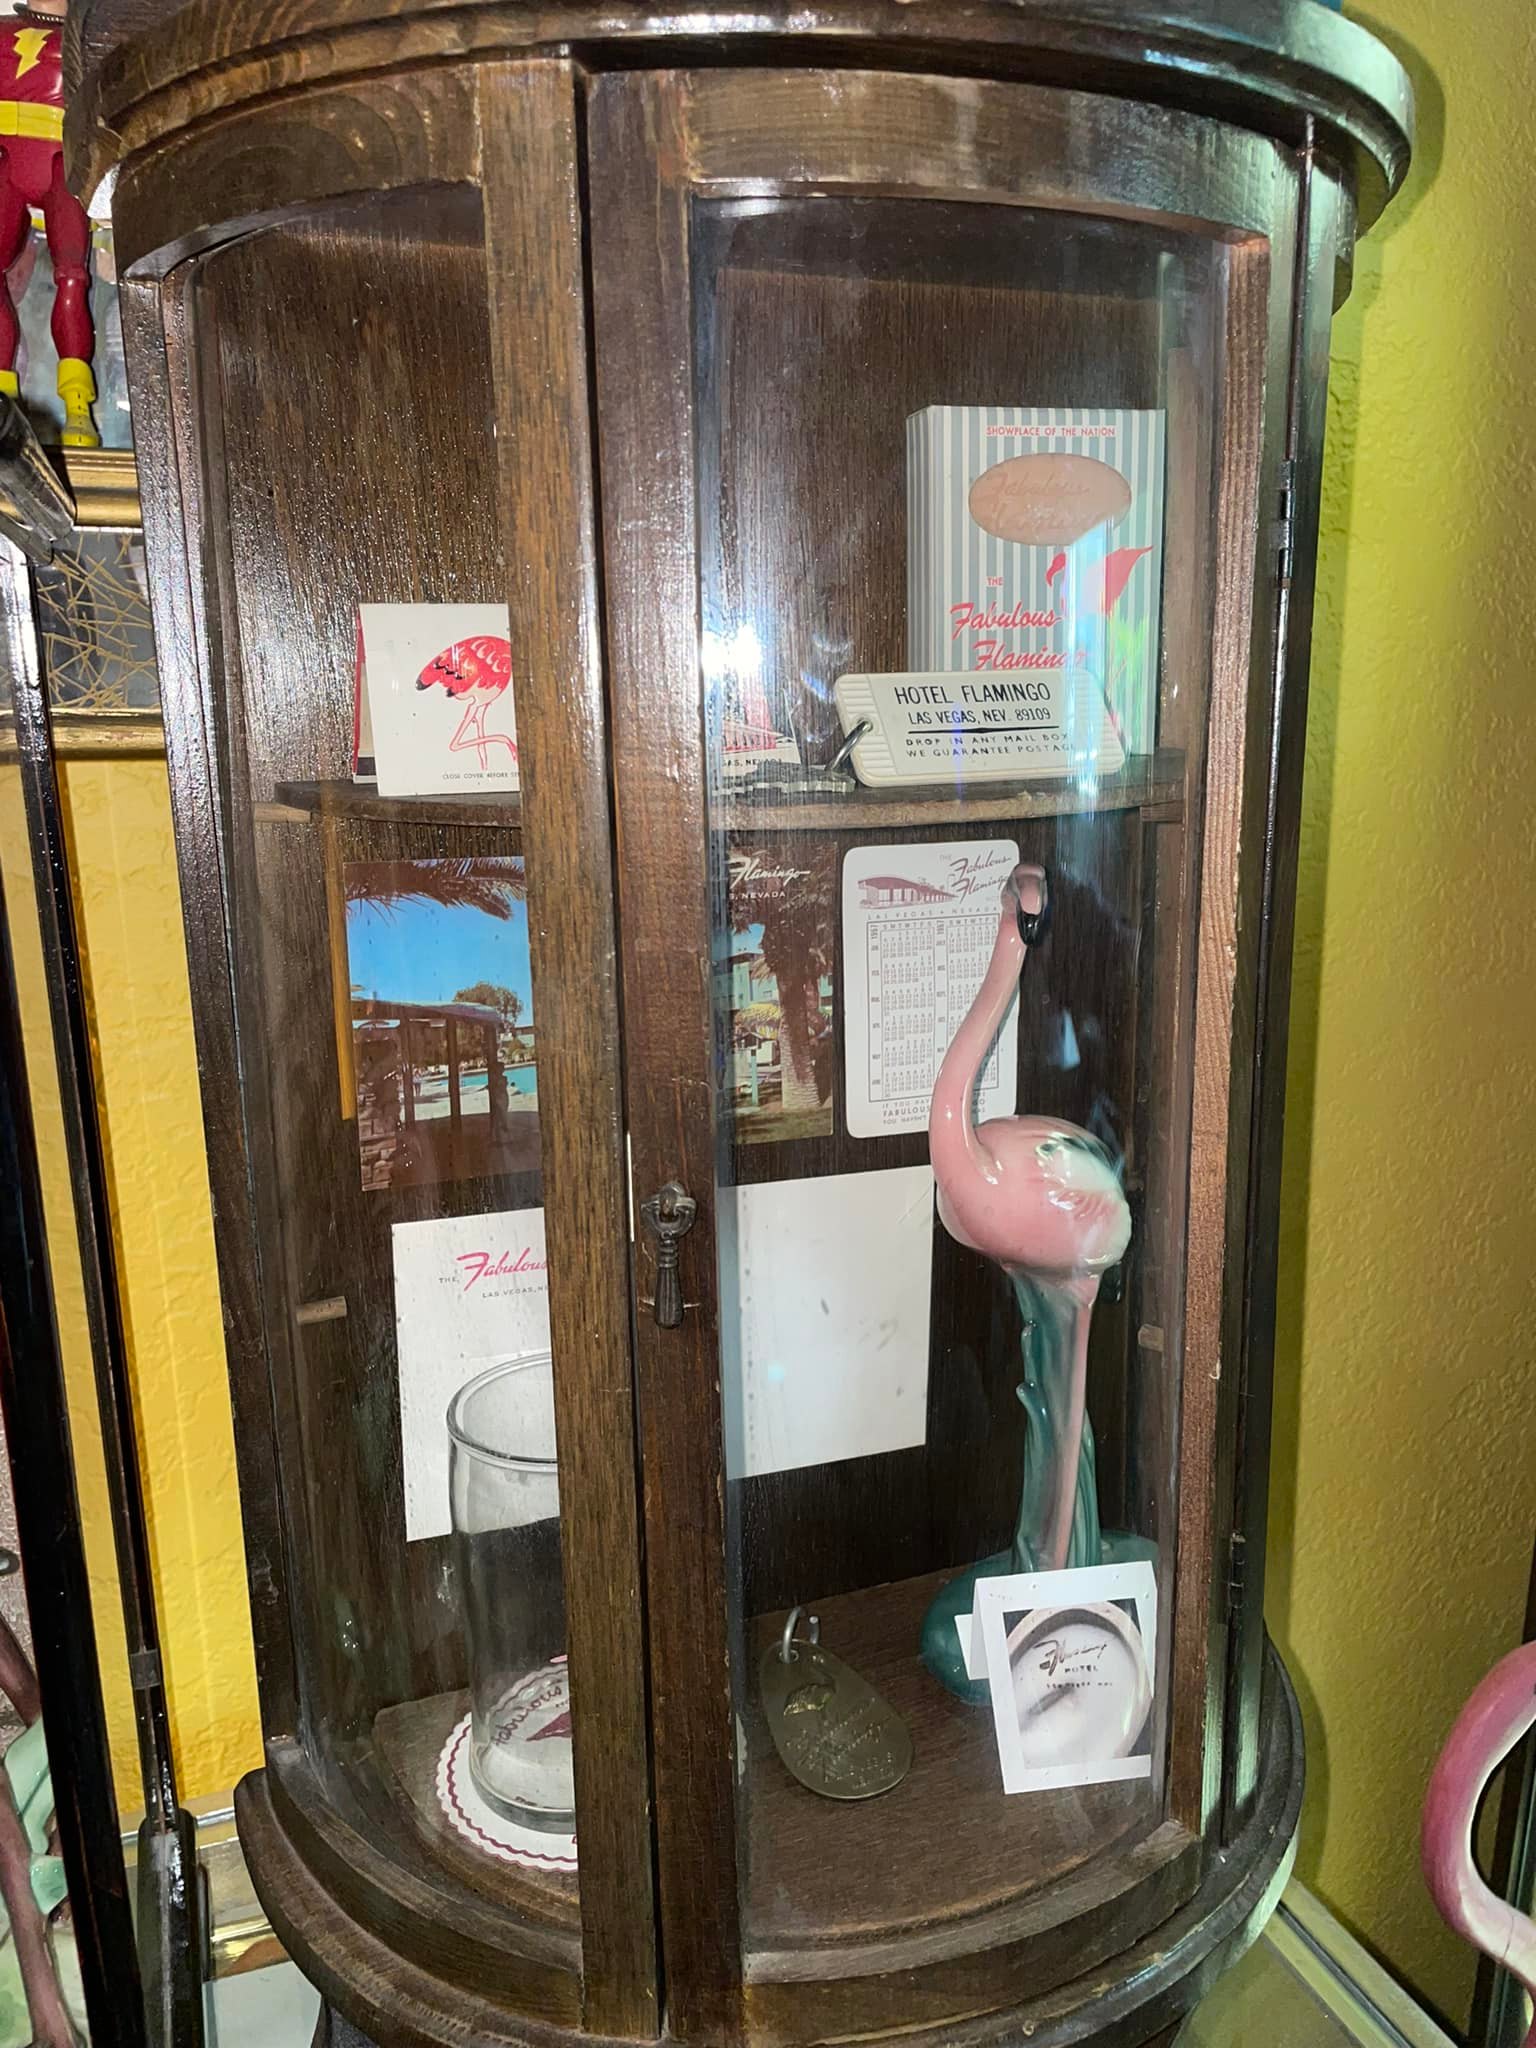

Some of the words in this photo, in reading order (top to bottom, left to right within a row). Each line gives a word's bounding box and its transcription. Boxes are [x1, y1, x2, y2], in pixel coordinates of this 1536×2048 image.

[986, 426, 1040, 436] SHOWPLACE
[1044, 426, 1056, 436] OF
[1061, 427, 1079, 437] THE
[1081, 426, 1116, 437] NATION
[987, 576, 1004, 587] THE
[950, 600, 1062, 641] Fabulous
[895, 685, 953, 705] HOTEL
[962, 682, 1051, 704] FLAMINGO
[909, 711, 932, 725] LAS
[938, 709, 980, 725] VEGAS,
[1016, 707, 1051, 721] 89109
[906, 738, 941, 747] DROP
[971, 736, 997, 745] ANY
[1004, 734, 1037, 743] MAIL
[907, 749, 926, 758] WE
[933, 747, 1011, 758] GUARANTEE
[728, 856, 811, 889] Flamingo
[741, 890, 786, 899] NEVADA
[482, 1290, 500, 1298] LAS
